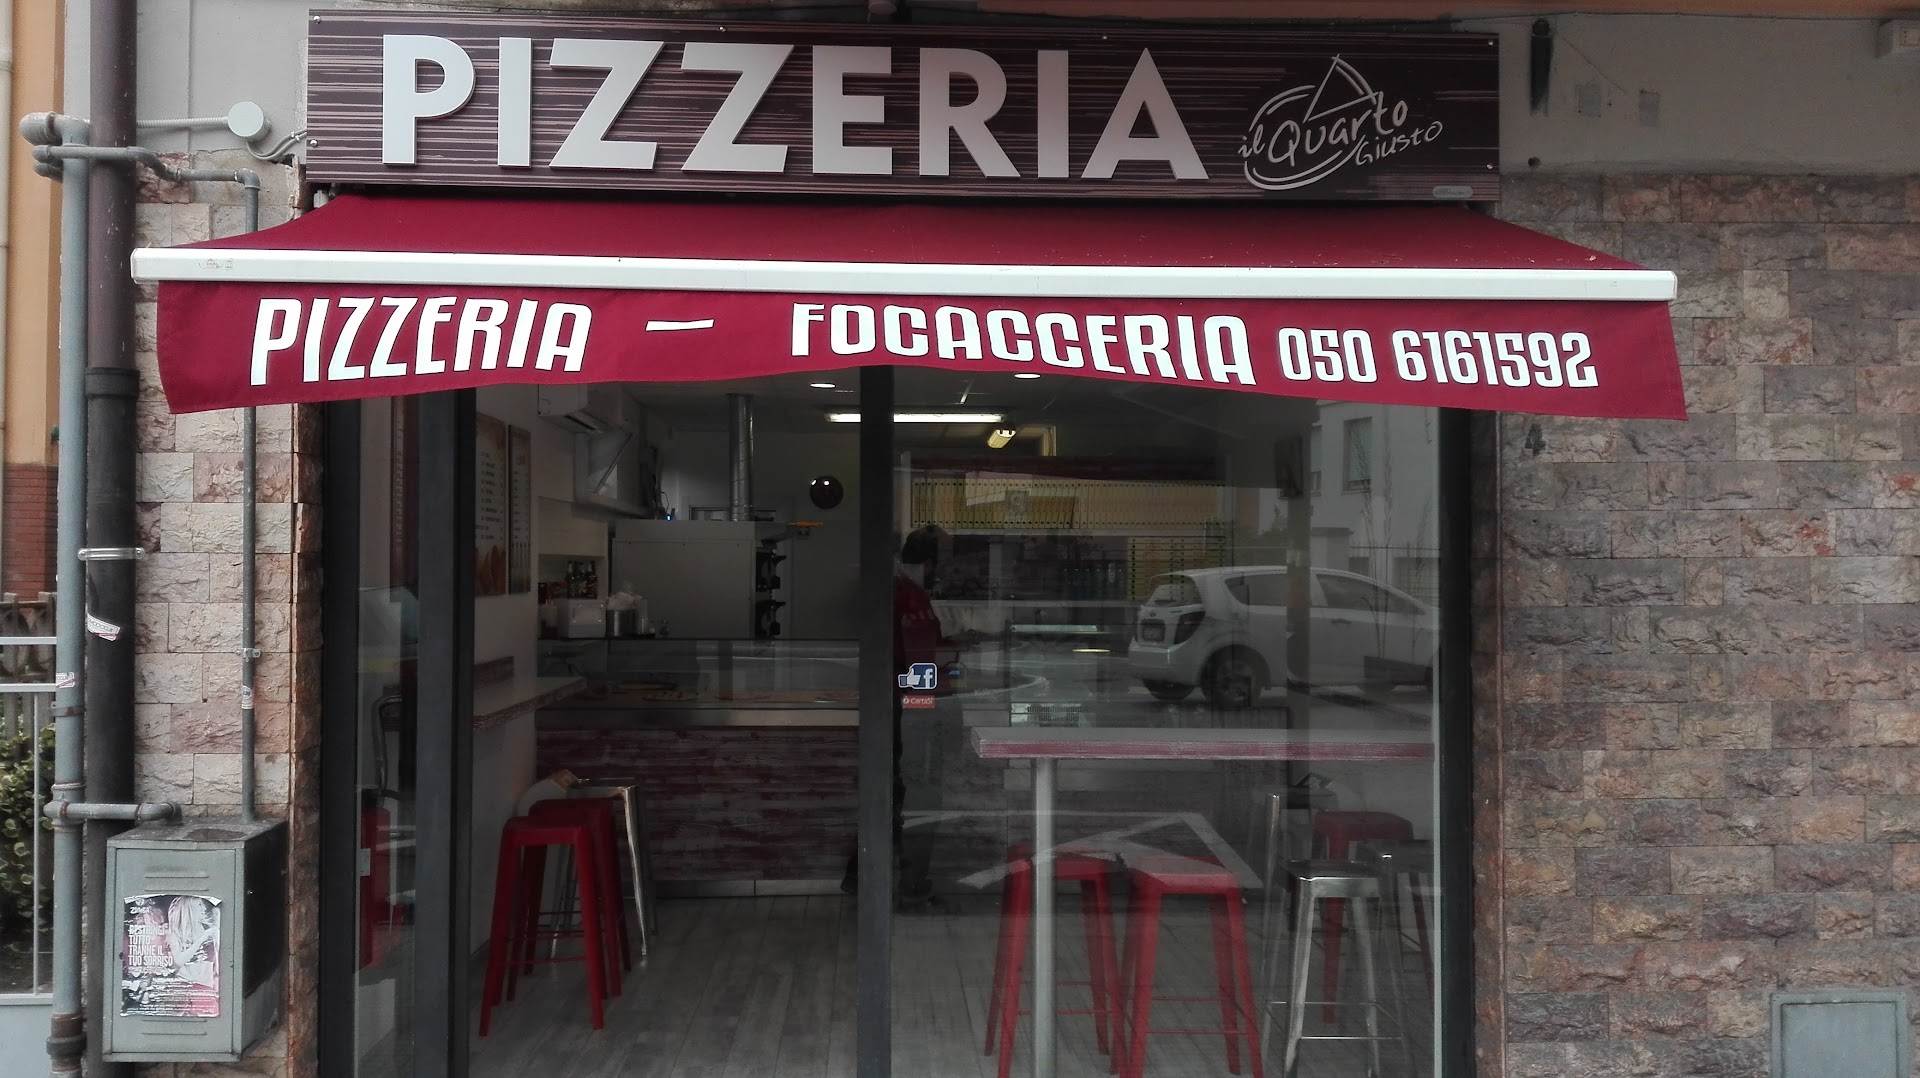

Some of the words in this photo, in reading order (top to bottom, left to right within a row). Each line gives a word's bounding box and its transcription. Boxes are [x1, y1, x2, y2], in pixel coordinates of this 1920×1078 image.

[382, 34, 1209, 181] PIZZERIA
[1237, 123, 1266, 158] il
[1268, 90, 1408, 167] Quarto
[250, 296, 593, 386] PIZZERIA
[791, 303, 1256, 386] FOCACCERIA
[1278, 327, 1377, 383] 050
[1392, 329, 1599, 388] 6161592
